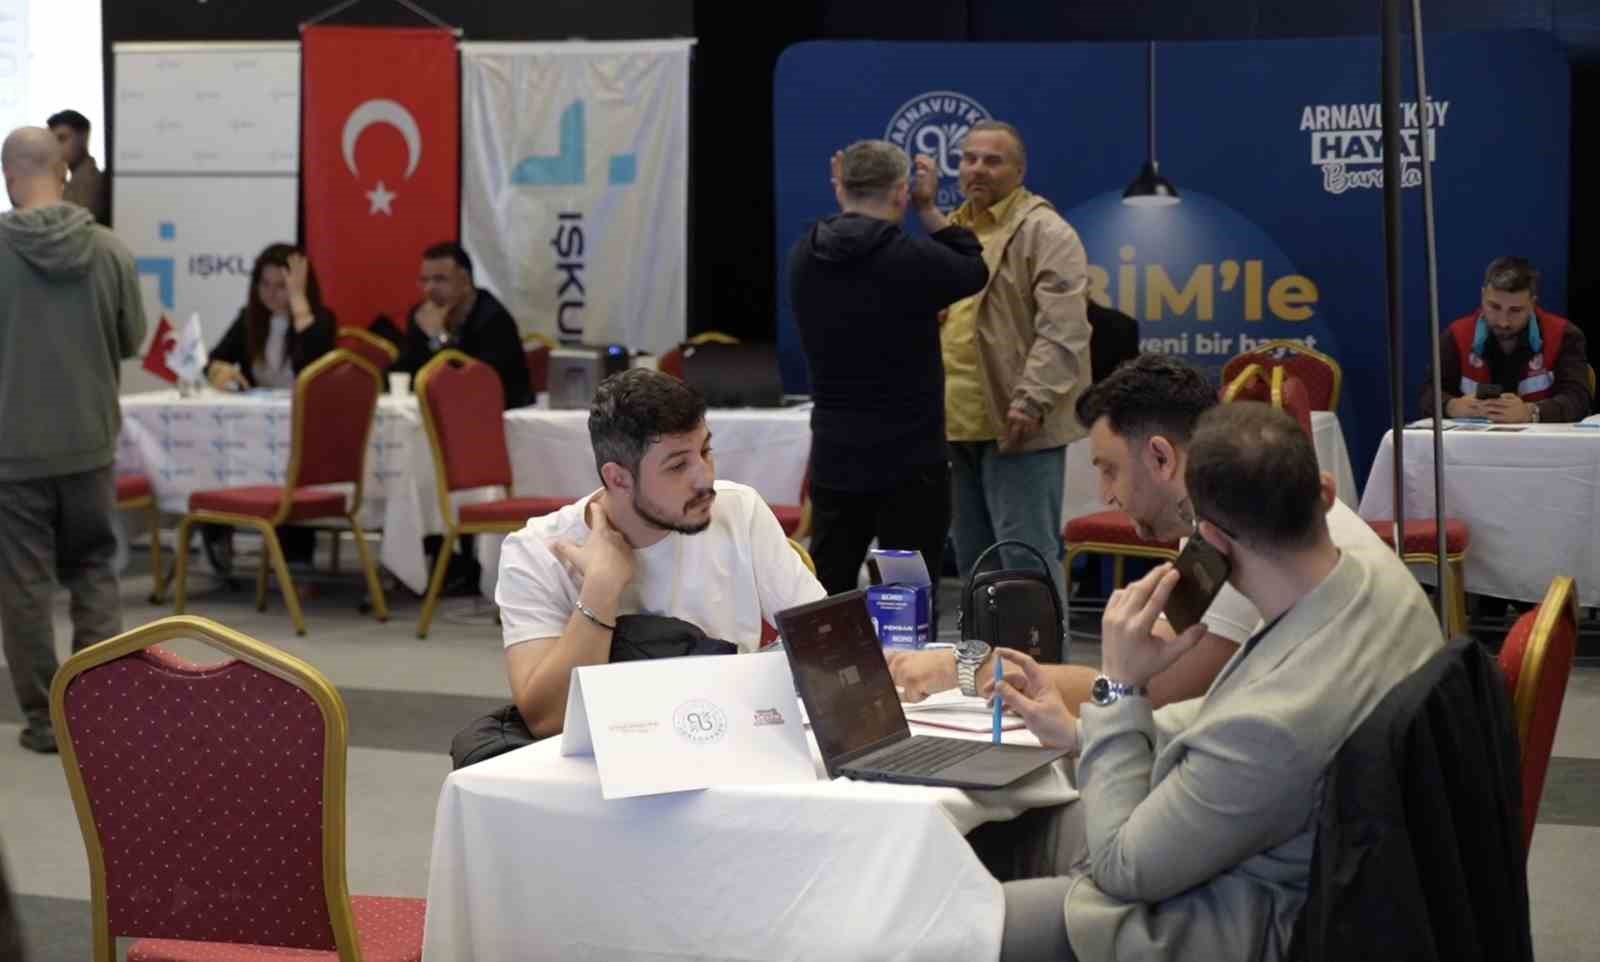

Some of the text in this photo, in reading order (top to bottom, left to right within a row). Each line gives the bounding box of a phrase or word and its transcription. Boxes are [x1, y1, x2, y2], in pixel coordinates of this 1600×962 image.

[1299, 95, 1449, 130] ARNAVKÖY
[550, 212, 585, 345] IŞKU
[1195, 332, 1233, 355] bir
